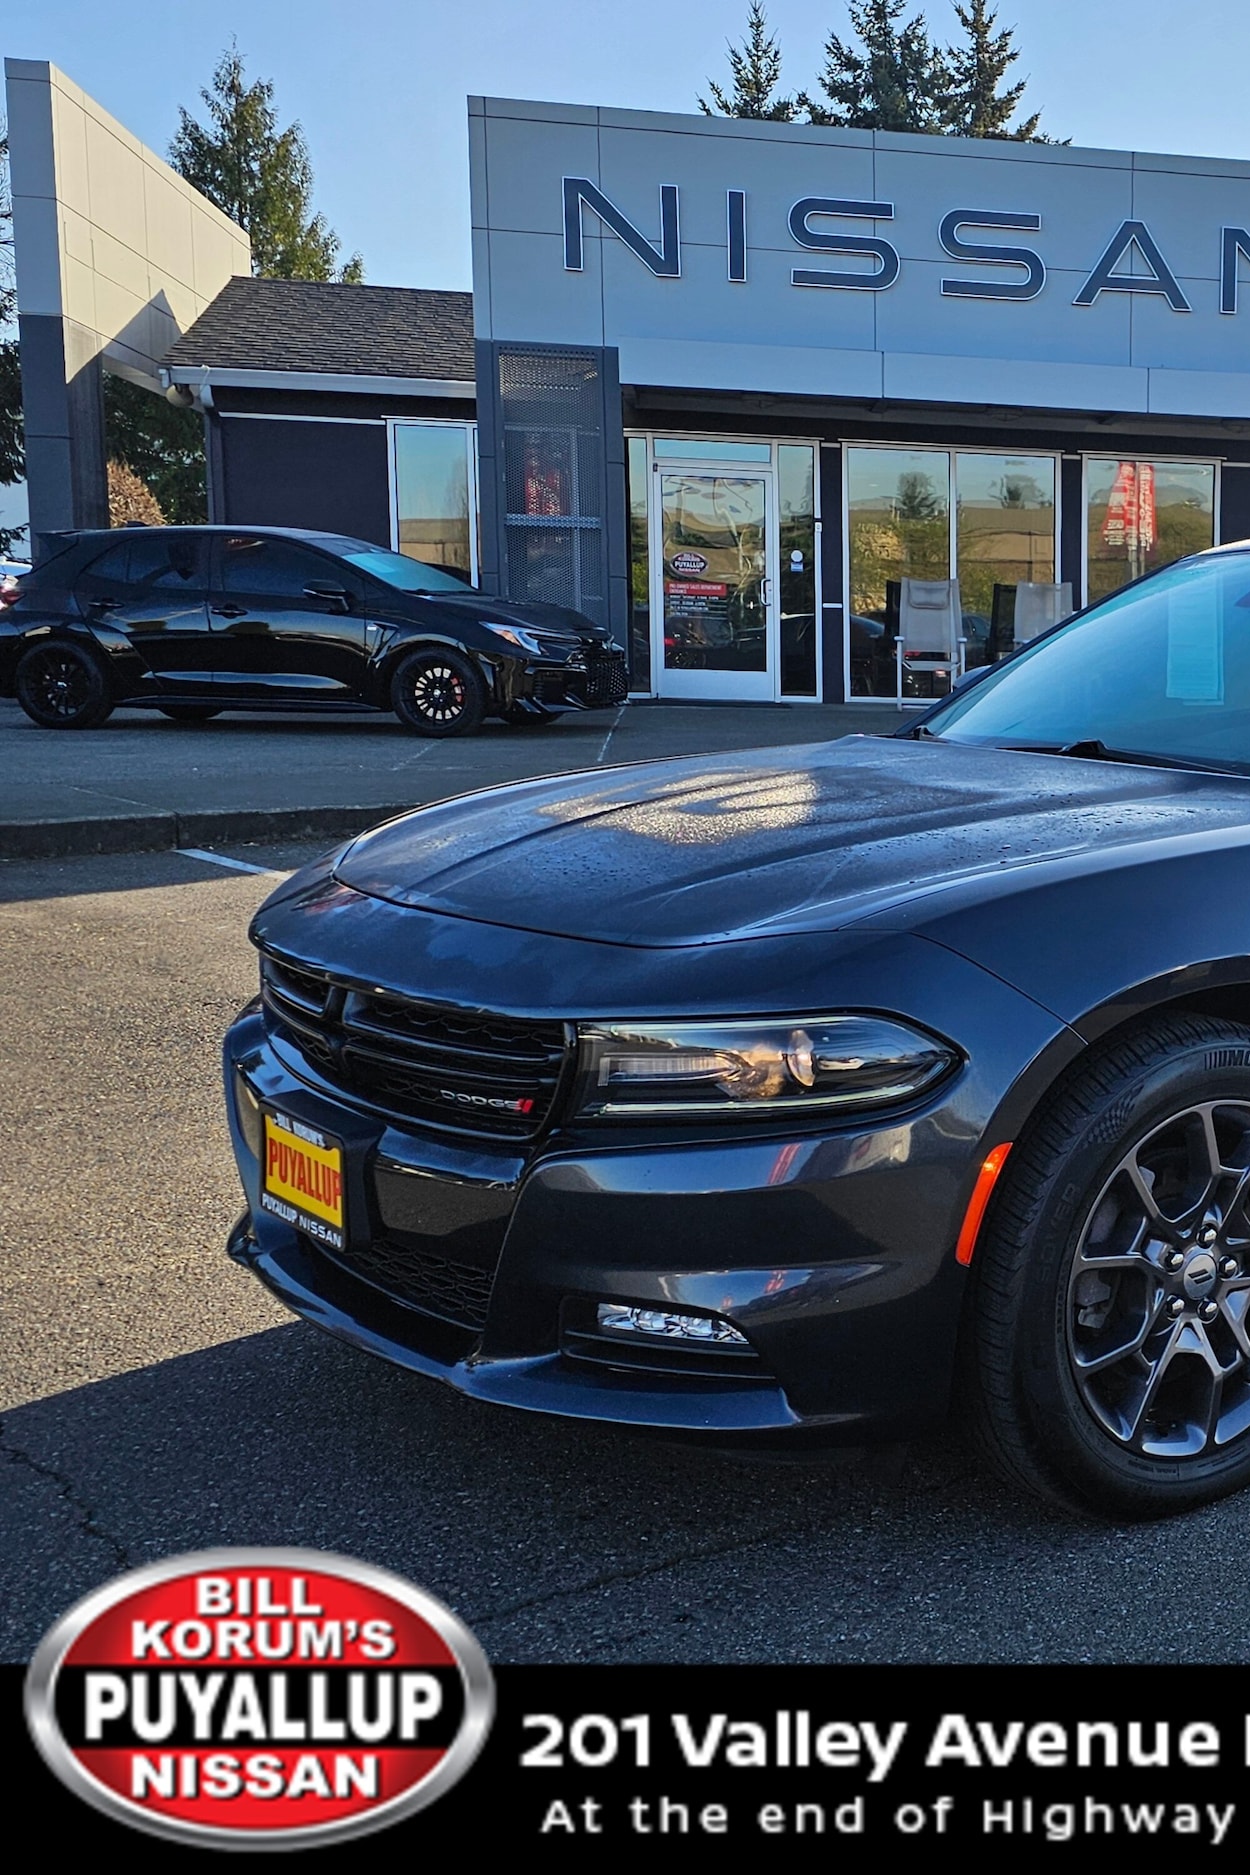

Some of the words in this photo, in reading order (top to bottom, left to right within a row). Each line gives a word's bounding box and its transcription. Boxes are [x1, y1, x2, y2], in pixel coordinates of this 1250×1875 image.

[674, 560, 705, 569] PUYALLUP
[440, 1089, 521, 1110] DODGE
[268, 1136, 342, 1212] PUYALLUP
[261, 1192, 299, 1224] PUYALLUP
[299, 1214, 343, 1248] NISSAN
